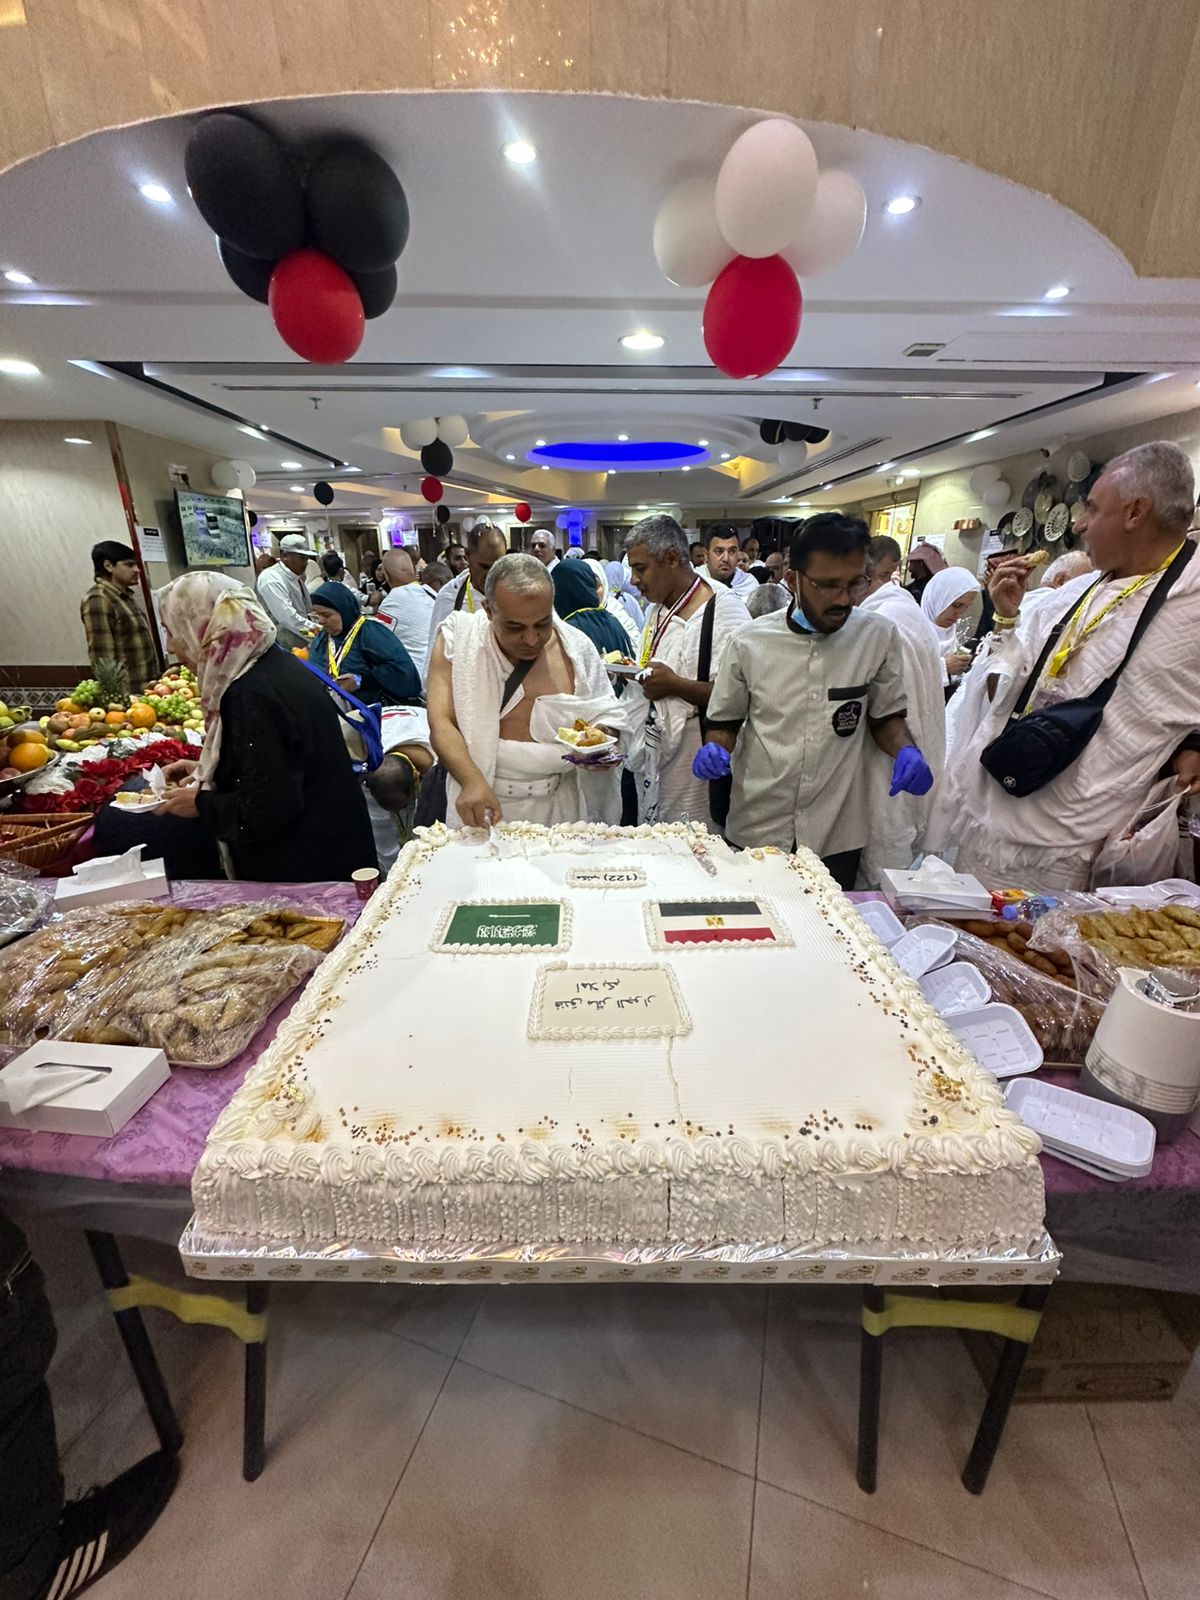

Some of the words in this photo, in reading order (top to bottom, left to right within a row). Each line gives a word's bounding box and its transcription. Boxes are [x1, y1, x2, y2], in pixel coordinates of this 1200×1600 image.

[603, 873, 638, 882] (122)
[602, 978, 620, 991] بكم
[554, 997, 583, 1010] فندق
[616, 995, 657, 1009] الجوار
